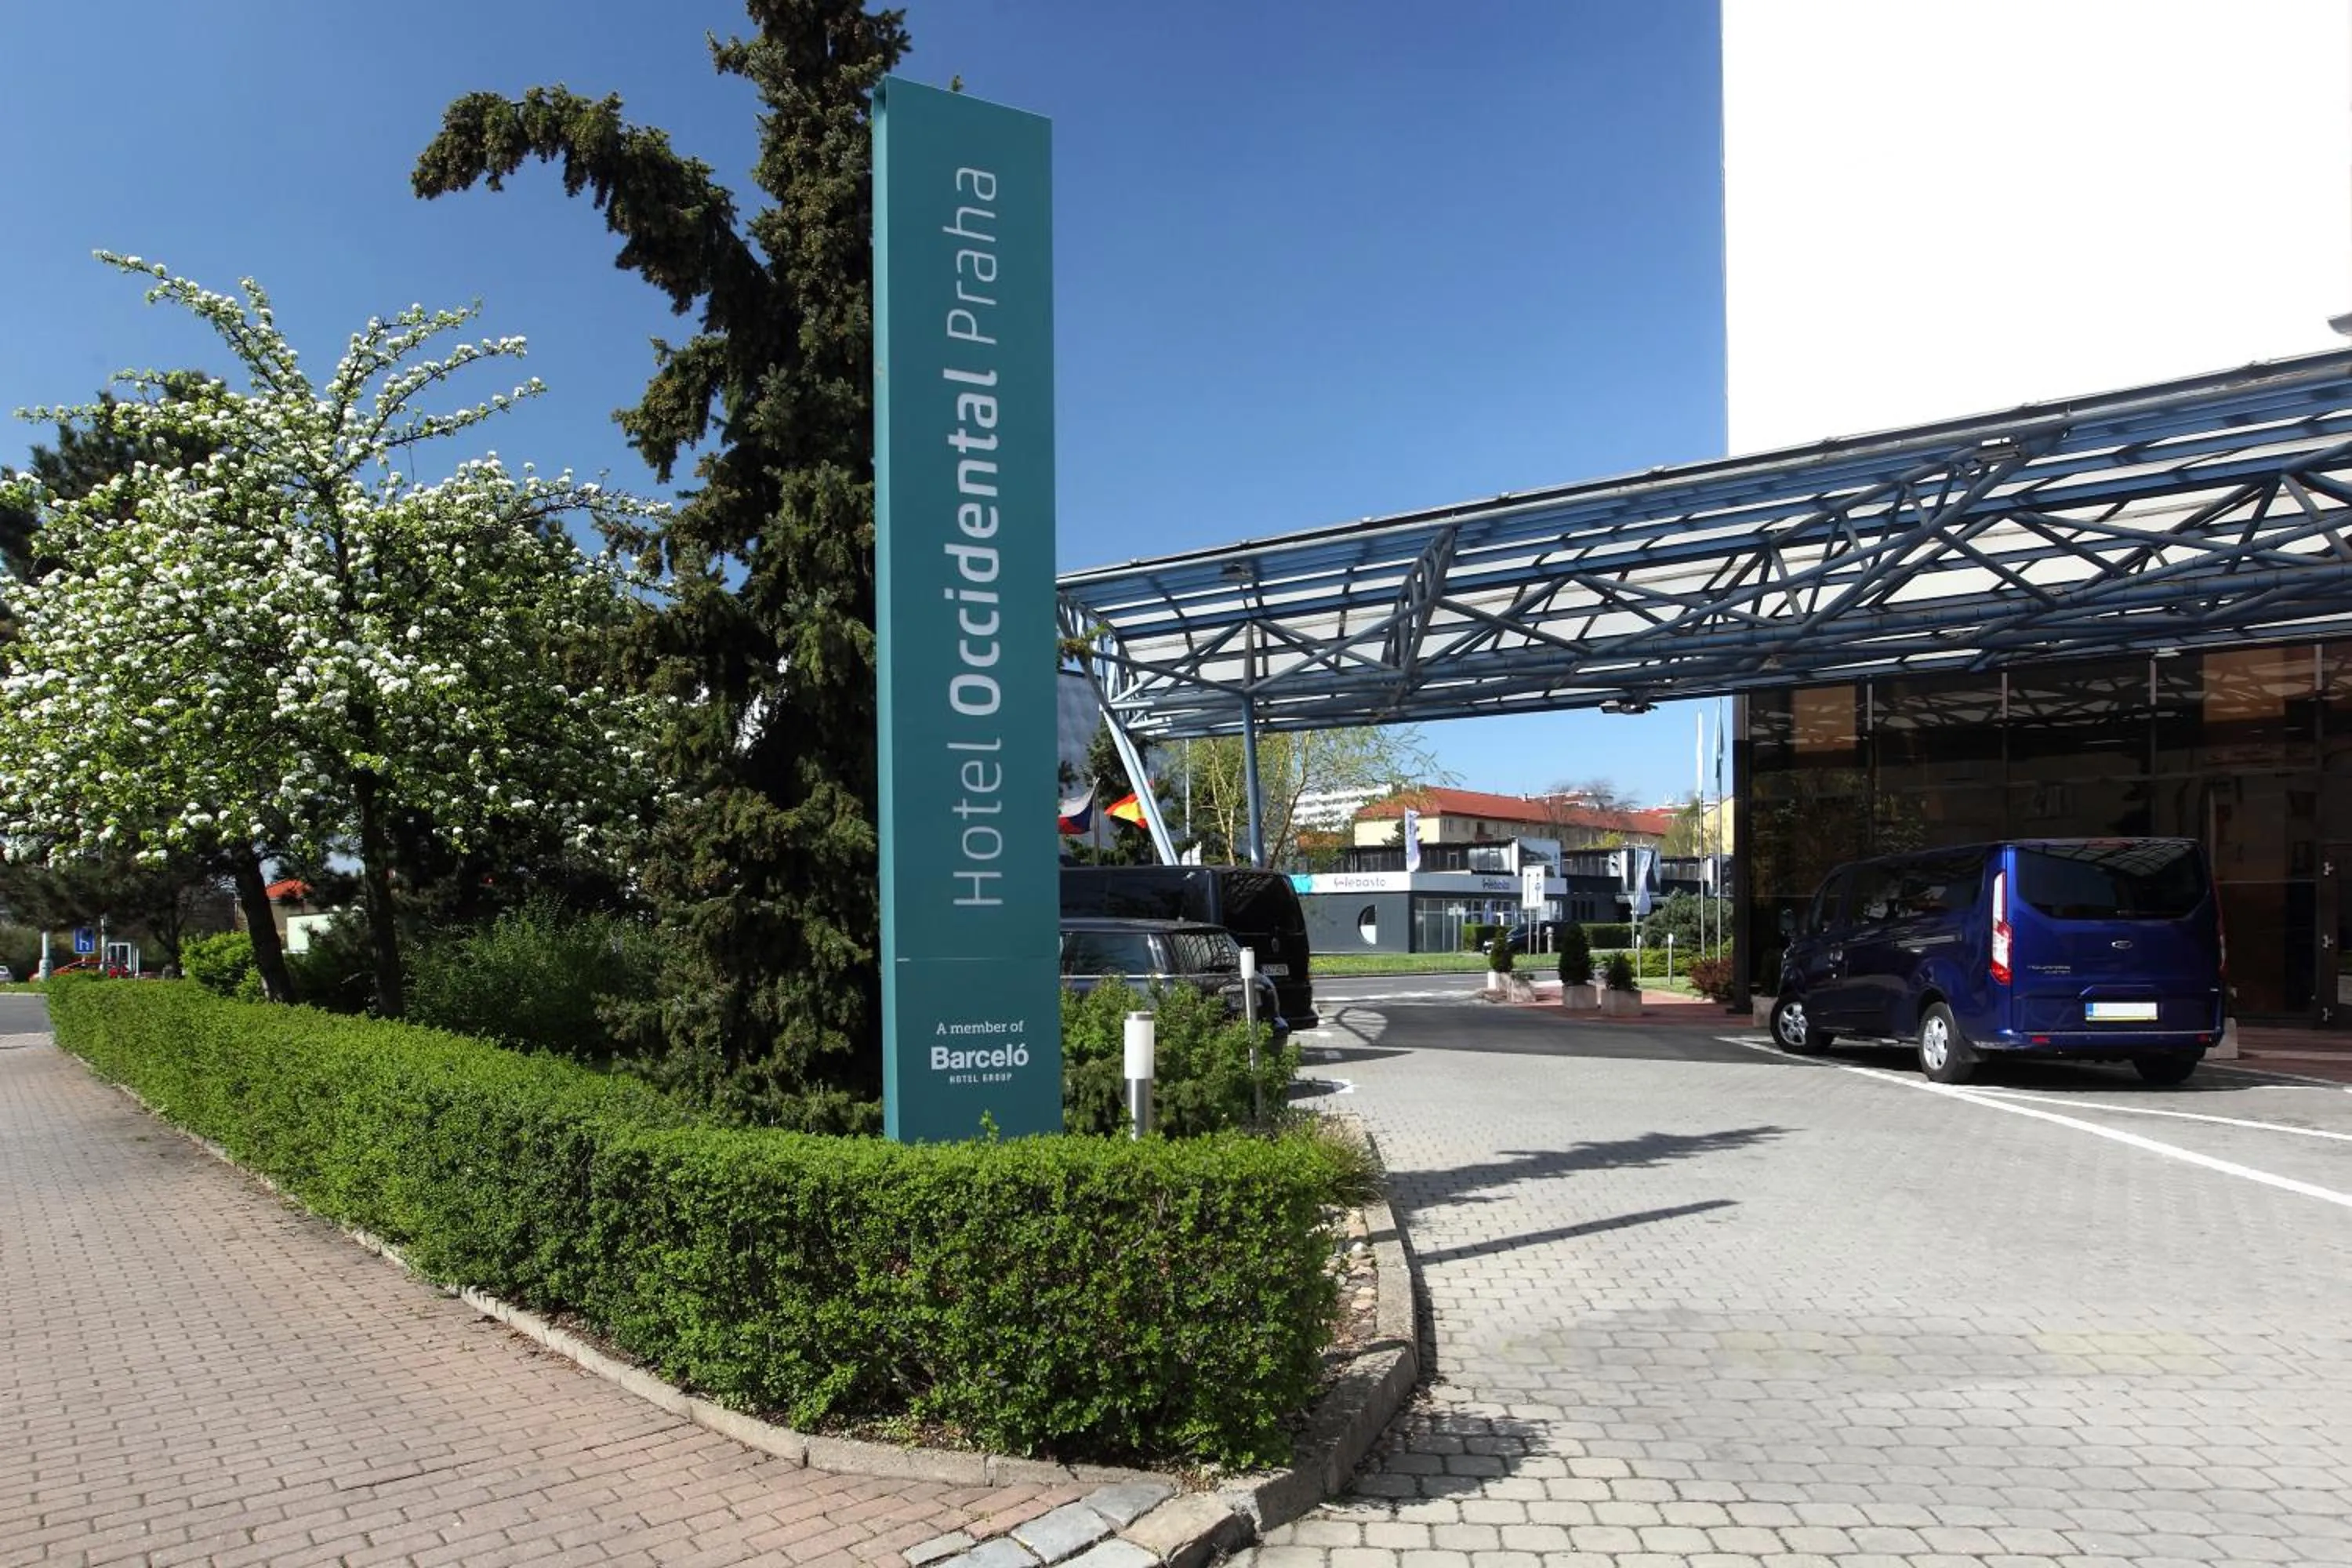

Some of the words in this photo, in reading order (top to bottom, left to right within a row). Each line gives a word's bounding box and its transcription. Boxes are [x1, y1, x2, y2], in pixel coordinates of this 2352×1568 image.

[942, 167, 996, 345] Praha
[943, 368, 1001, 716] Occidental
[947, 738, 1002, 905] Hotel
[931, 1044, 1029, 1069] Barceló
[936, 1022, 946, 1035] A
[950, 1021, 1007, 1033] member
[1010, 1020, 1025, 1033] of
[949, 1074, 978, 1083] HOTEL
[982, 1073, 1012, 1082] GROUP
